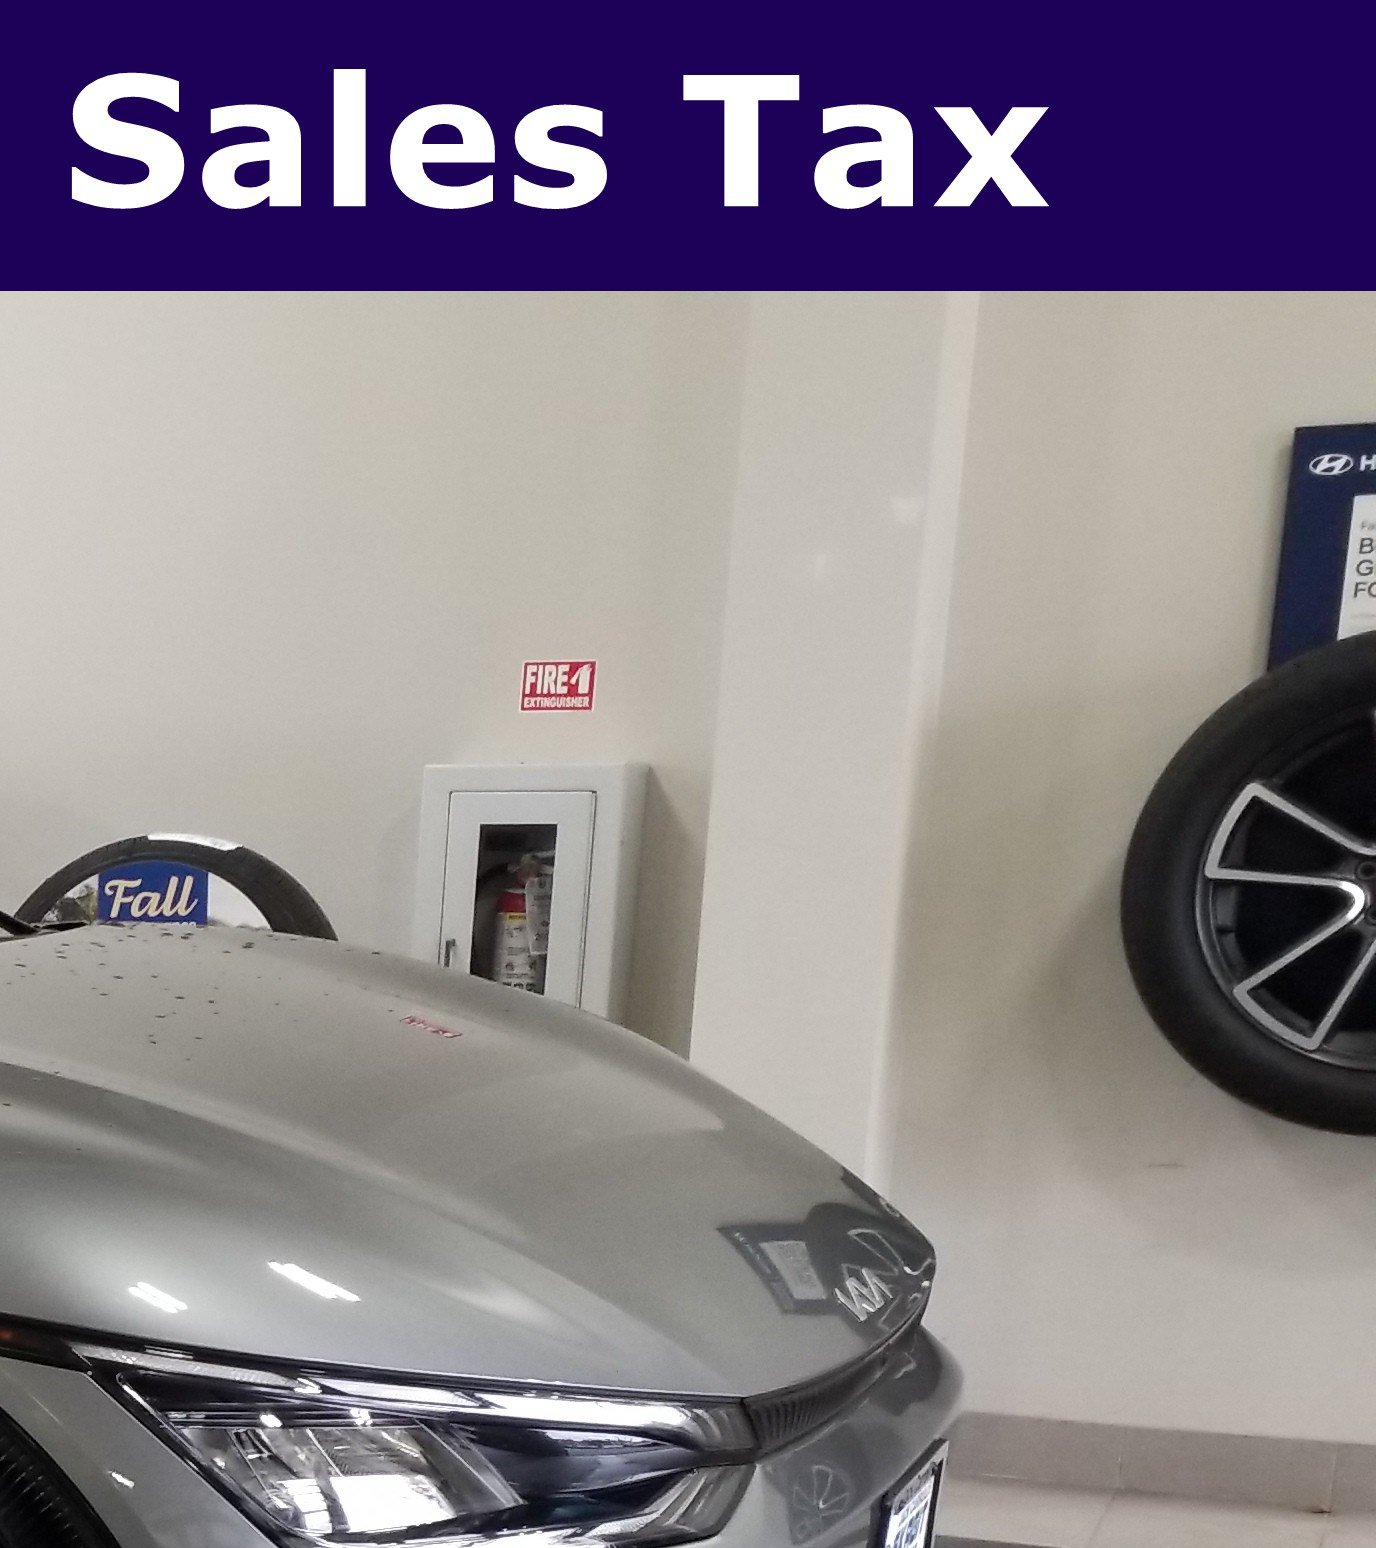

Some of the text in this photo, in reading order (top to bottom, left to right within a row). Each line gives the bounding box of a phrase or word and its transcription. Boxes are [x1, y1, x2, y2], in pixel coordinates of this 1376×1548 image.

[524, 664, 570, 695] FIRE
[523, 696, 590, 708] EXTINGUISHER
[104, 875, 199, 919] Fall
